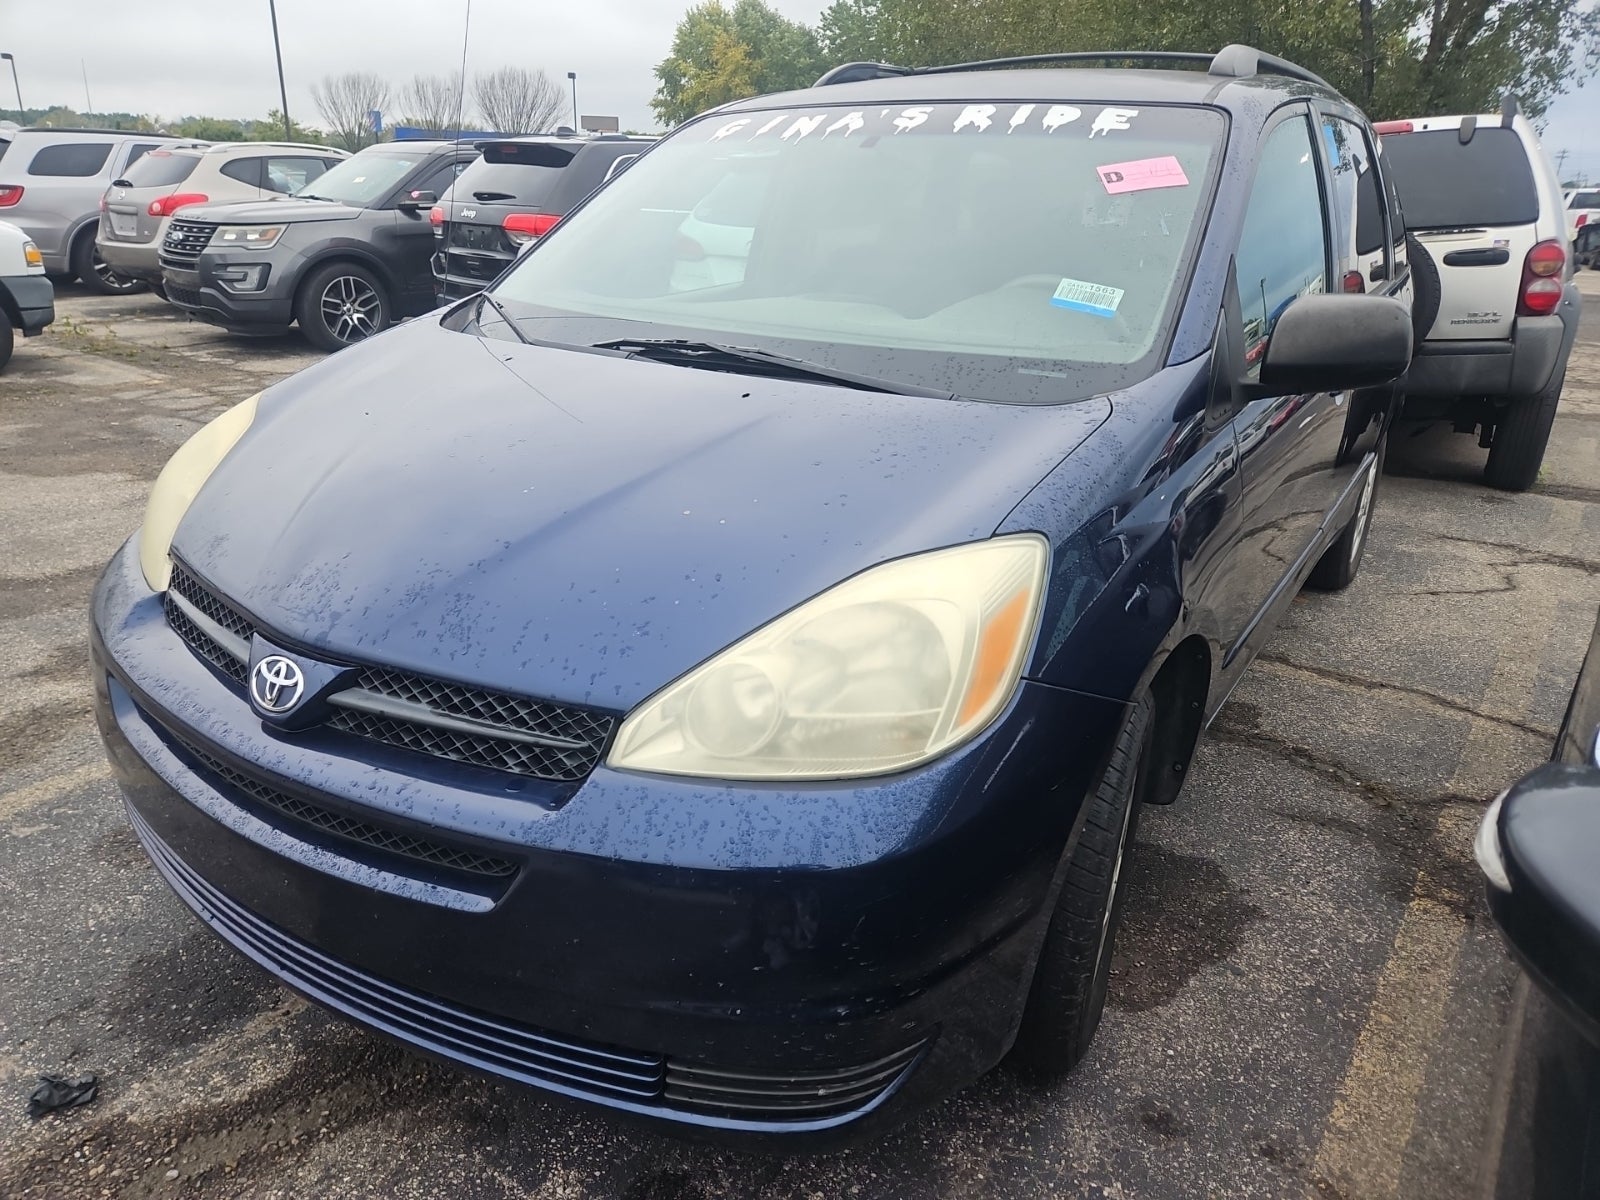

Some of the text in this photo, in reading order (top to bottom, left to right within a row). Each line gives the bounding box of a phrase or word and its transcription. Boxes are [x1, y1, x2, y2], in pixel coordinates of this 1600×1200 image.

[953, 104, 1140, 139] RIDE
[1103, 172, 1124, 184] D
[460, 207, 477, 219] Jeep
